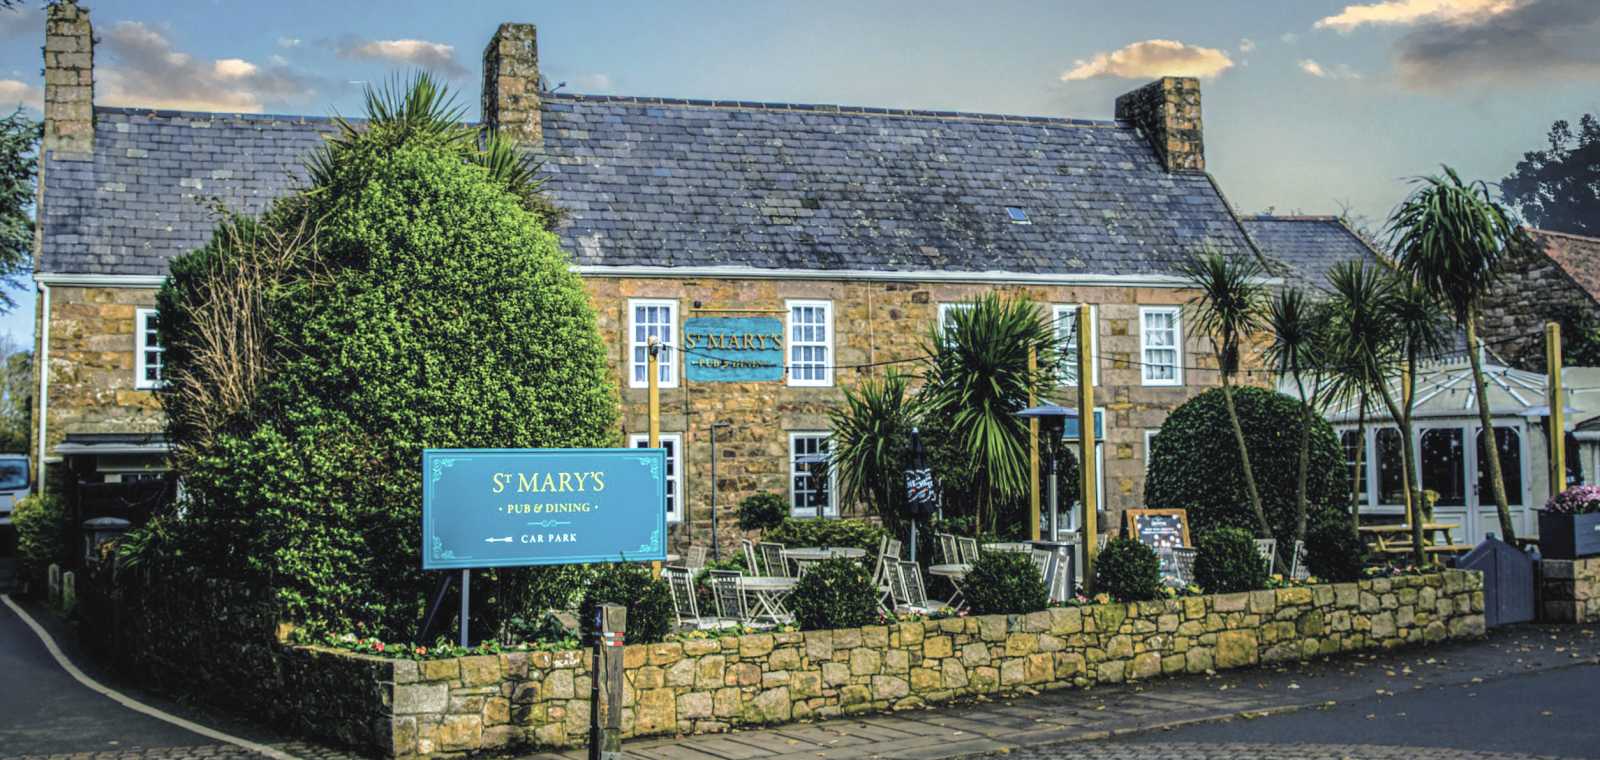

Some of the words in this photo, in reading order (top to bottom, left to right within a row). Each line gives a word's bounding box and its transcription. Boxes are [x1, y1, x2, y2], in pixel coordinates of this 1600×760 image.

[707, 333, 784, 350] MARY'S
[699, 358, 721, 368] PUB
[517, 471, 605, 493] MARY'S
[507, 504, 531, 514] PUB
[533, 504, 542, 513] &
[545, 503, 591, 513] DINING
[520, 534, 544, 544] CAR
[548, 533, 577, 543] PARK
